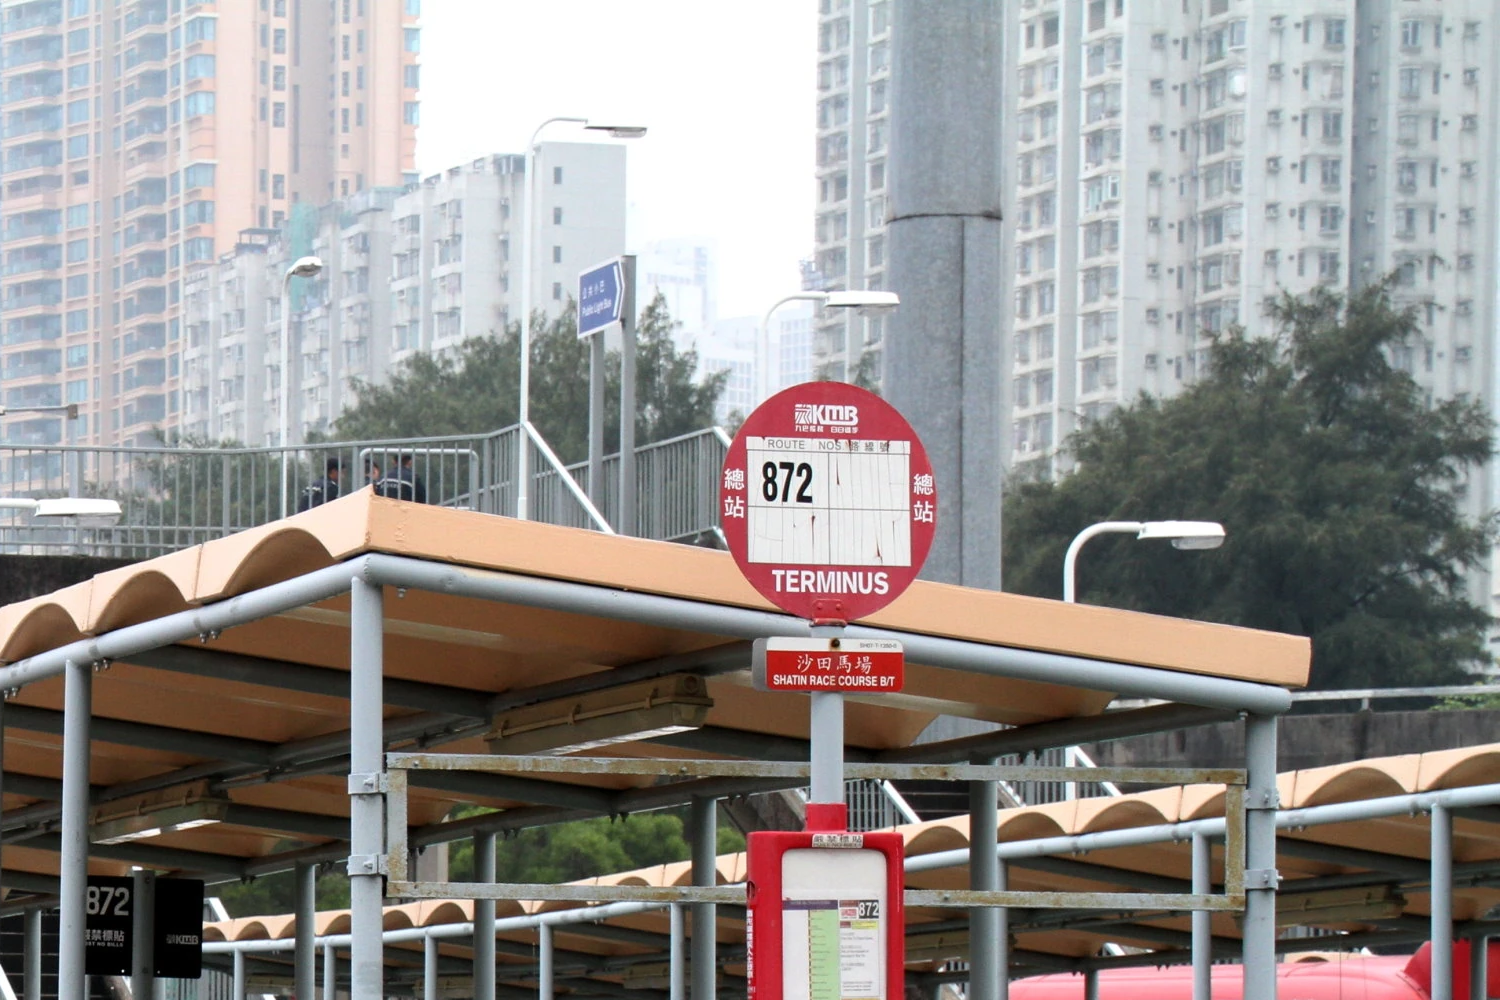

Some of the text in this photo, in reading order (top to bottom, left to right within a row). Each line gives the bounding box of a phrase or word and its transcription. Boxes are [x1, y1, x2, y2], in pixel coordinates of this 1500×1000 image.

[813, 404, 858, 426] KMB
[767, 438, 842, 451] ROUTE NOS
[724, 468, 745, 518] 總站
[762, 461, 813, 504] 872
[913, 473, 934, 523] 總站
[771, 570, 889, 595] TERMINUS
[797, 654, 872, 675] 沙田馬場
[773, 674, 895, 687] SHATIN RACE COURSE B/T
[87, 886, 130, 916] 872
[859, 902, 879, 917] 872
